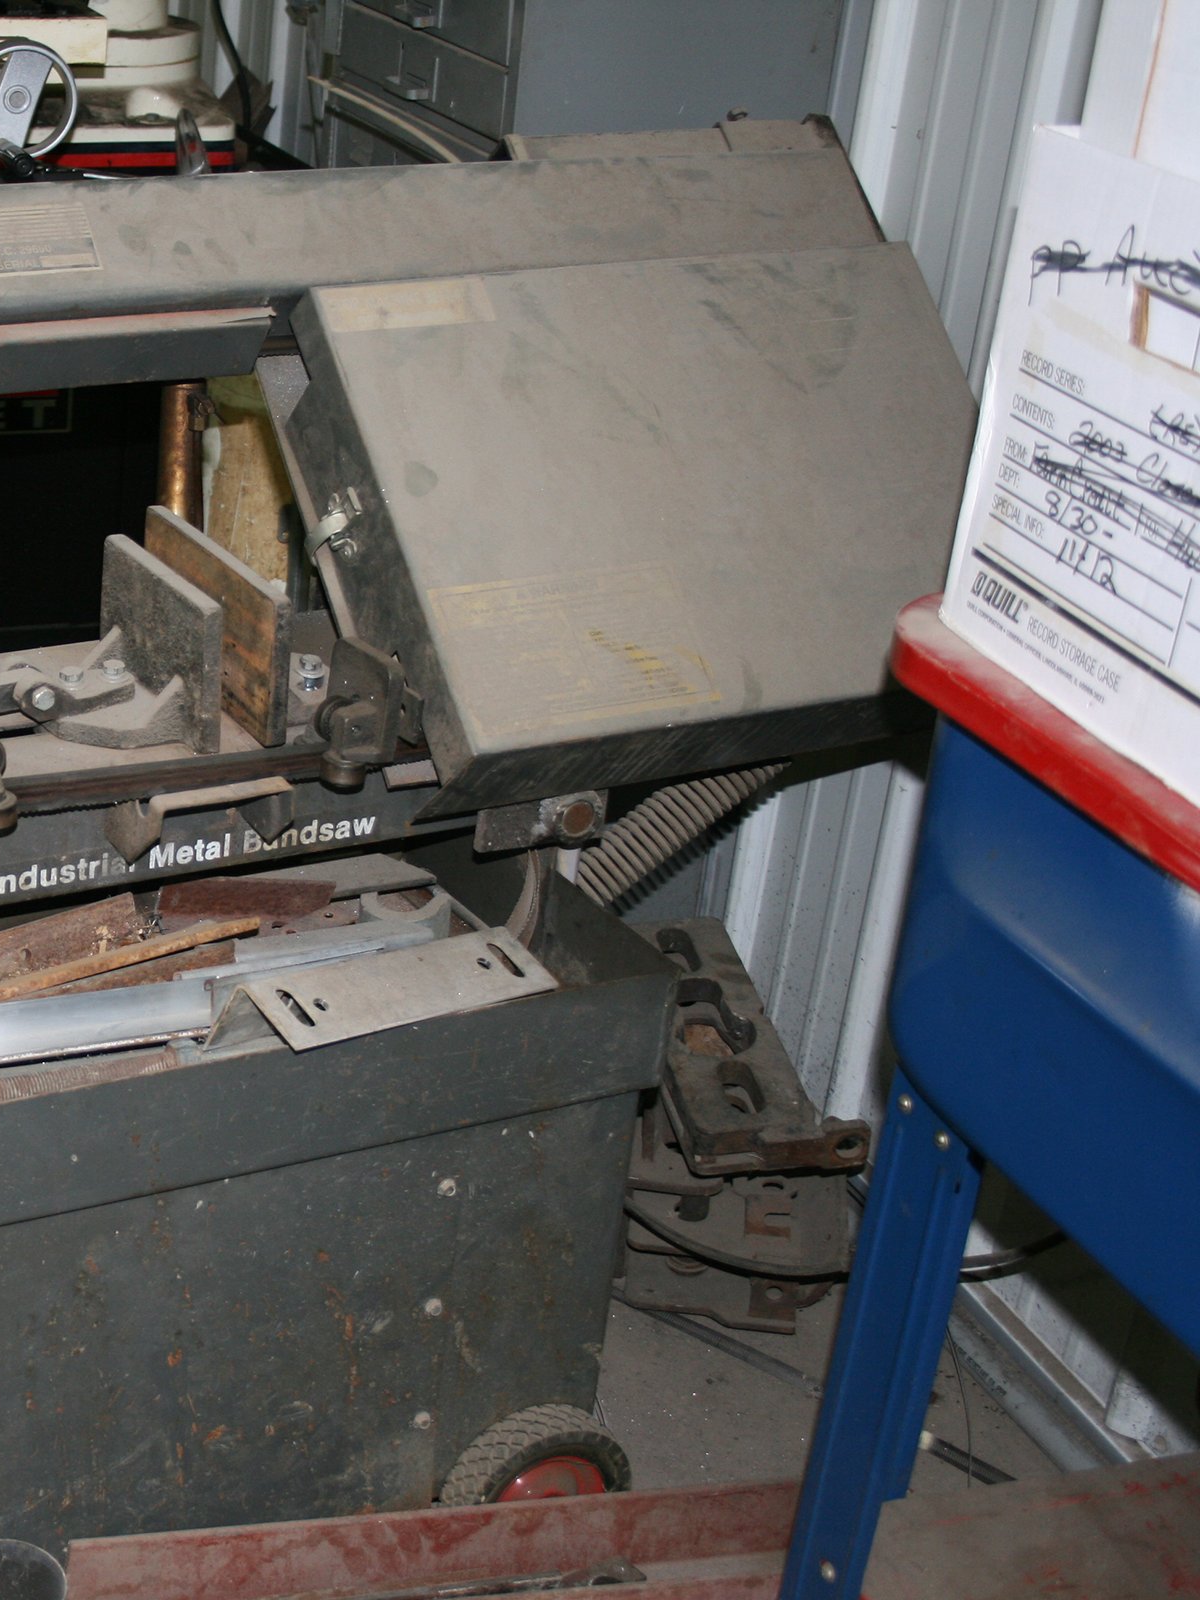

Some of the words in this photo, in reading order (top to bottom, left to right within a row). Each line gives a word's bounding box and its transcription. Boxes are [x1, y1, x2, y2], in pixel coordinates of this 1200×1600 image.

[1021, 350, 1054, 378] RECORD
[1054, 365, 1086, 396] SERIES:
[1012, 393, 1056, 429] CONTENTS:
[1003, 436, 1028, 468] FROM:
[998, 463, 1021, 489] DEPT:
[992, 493, 1023, 527] SPECIAL
[1024, 513, 1046, 540] INFO:
[982, 578, 1024, 624] QUILL
[1027, 616, 1059, 650] RECORD
[1058, 639, 1097, 679] STORAGE
[1097, 665, 1121, 693] CASE
[149, 833, 231, 869] Metal
